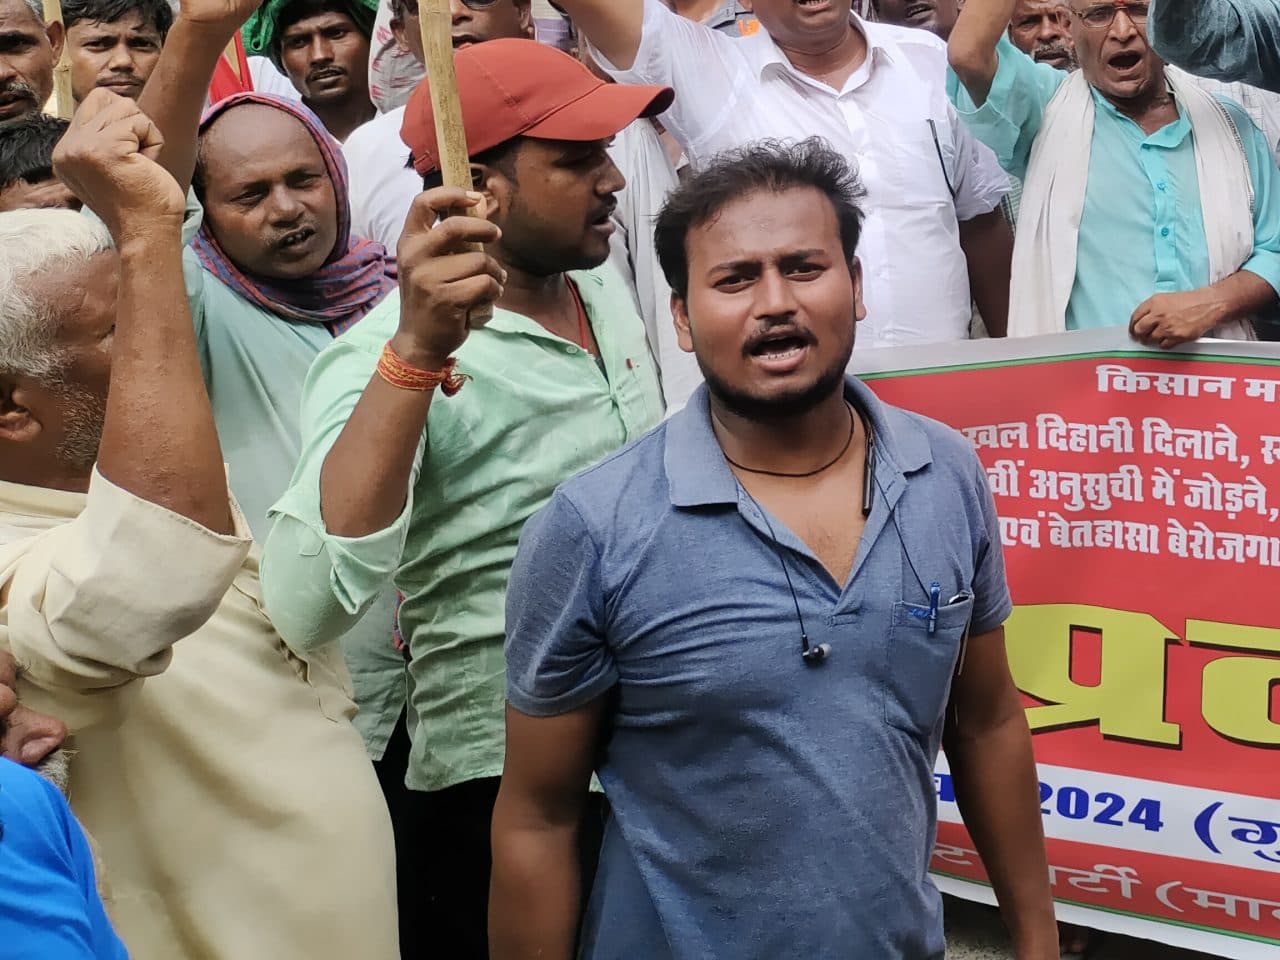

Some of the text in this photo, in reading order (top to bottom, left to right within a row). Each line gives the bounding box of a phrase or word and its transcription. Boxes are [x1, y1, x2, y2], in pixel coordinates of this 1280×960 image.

[1096, 365, 1236, 400] किसान
[1036, 413, 1135, 454] दिहानी
[1142, 417, 1250, 470] दिलाने,
[987, 459, 1025, 497] वीं
[1029, 464, 1145, 512] अनुसुची
[1152, 466, 1181, 507] में
[1183, 472, 1280, 522] जोड़ने,
[1048, 512, 1160, 555] बेतहासा
[1039, 782, 1164, 834] 2024
[1047, 863, 1142, 900] ार्टी
